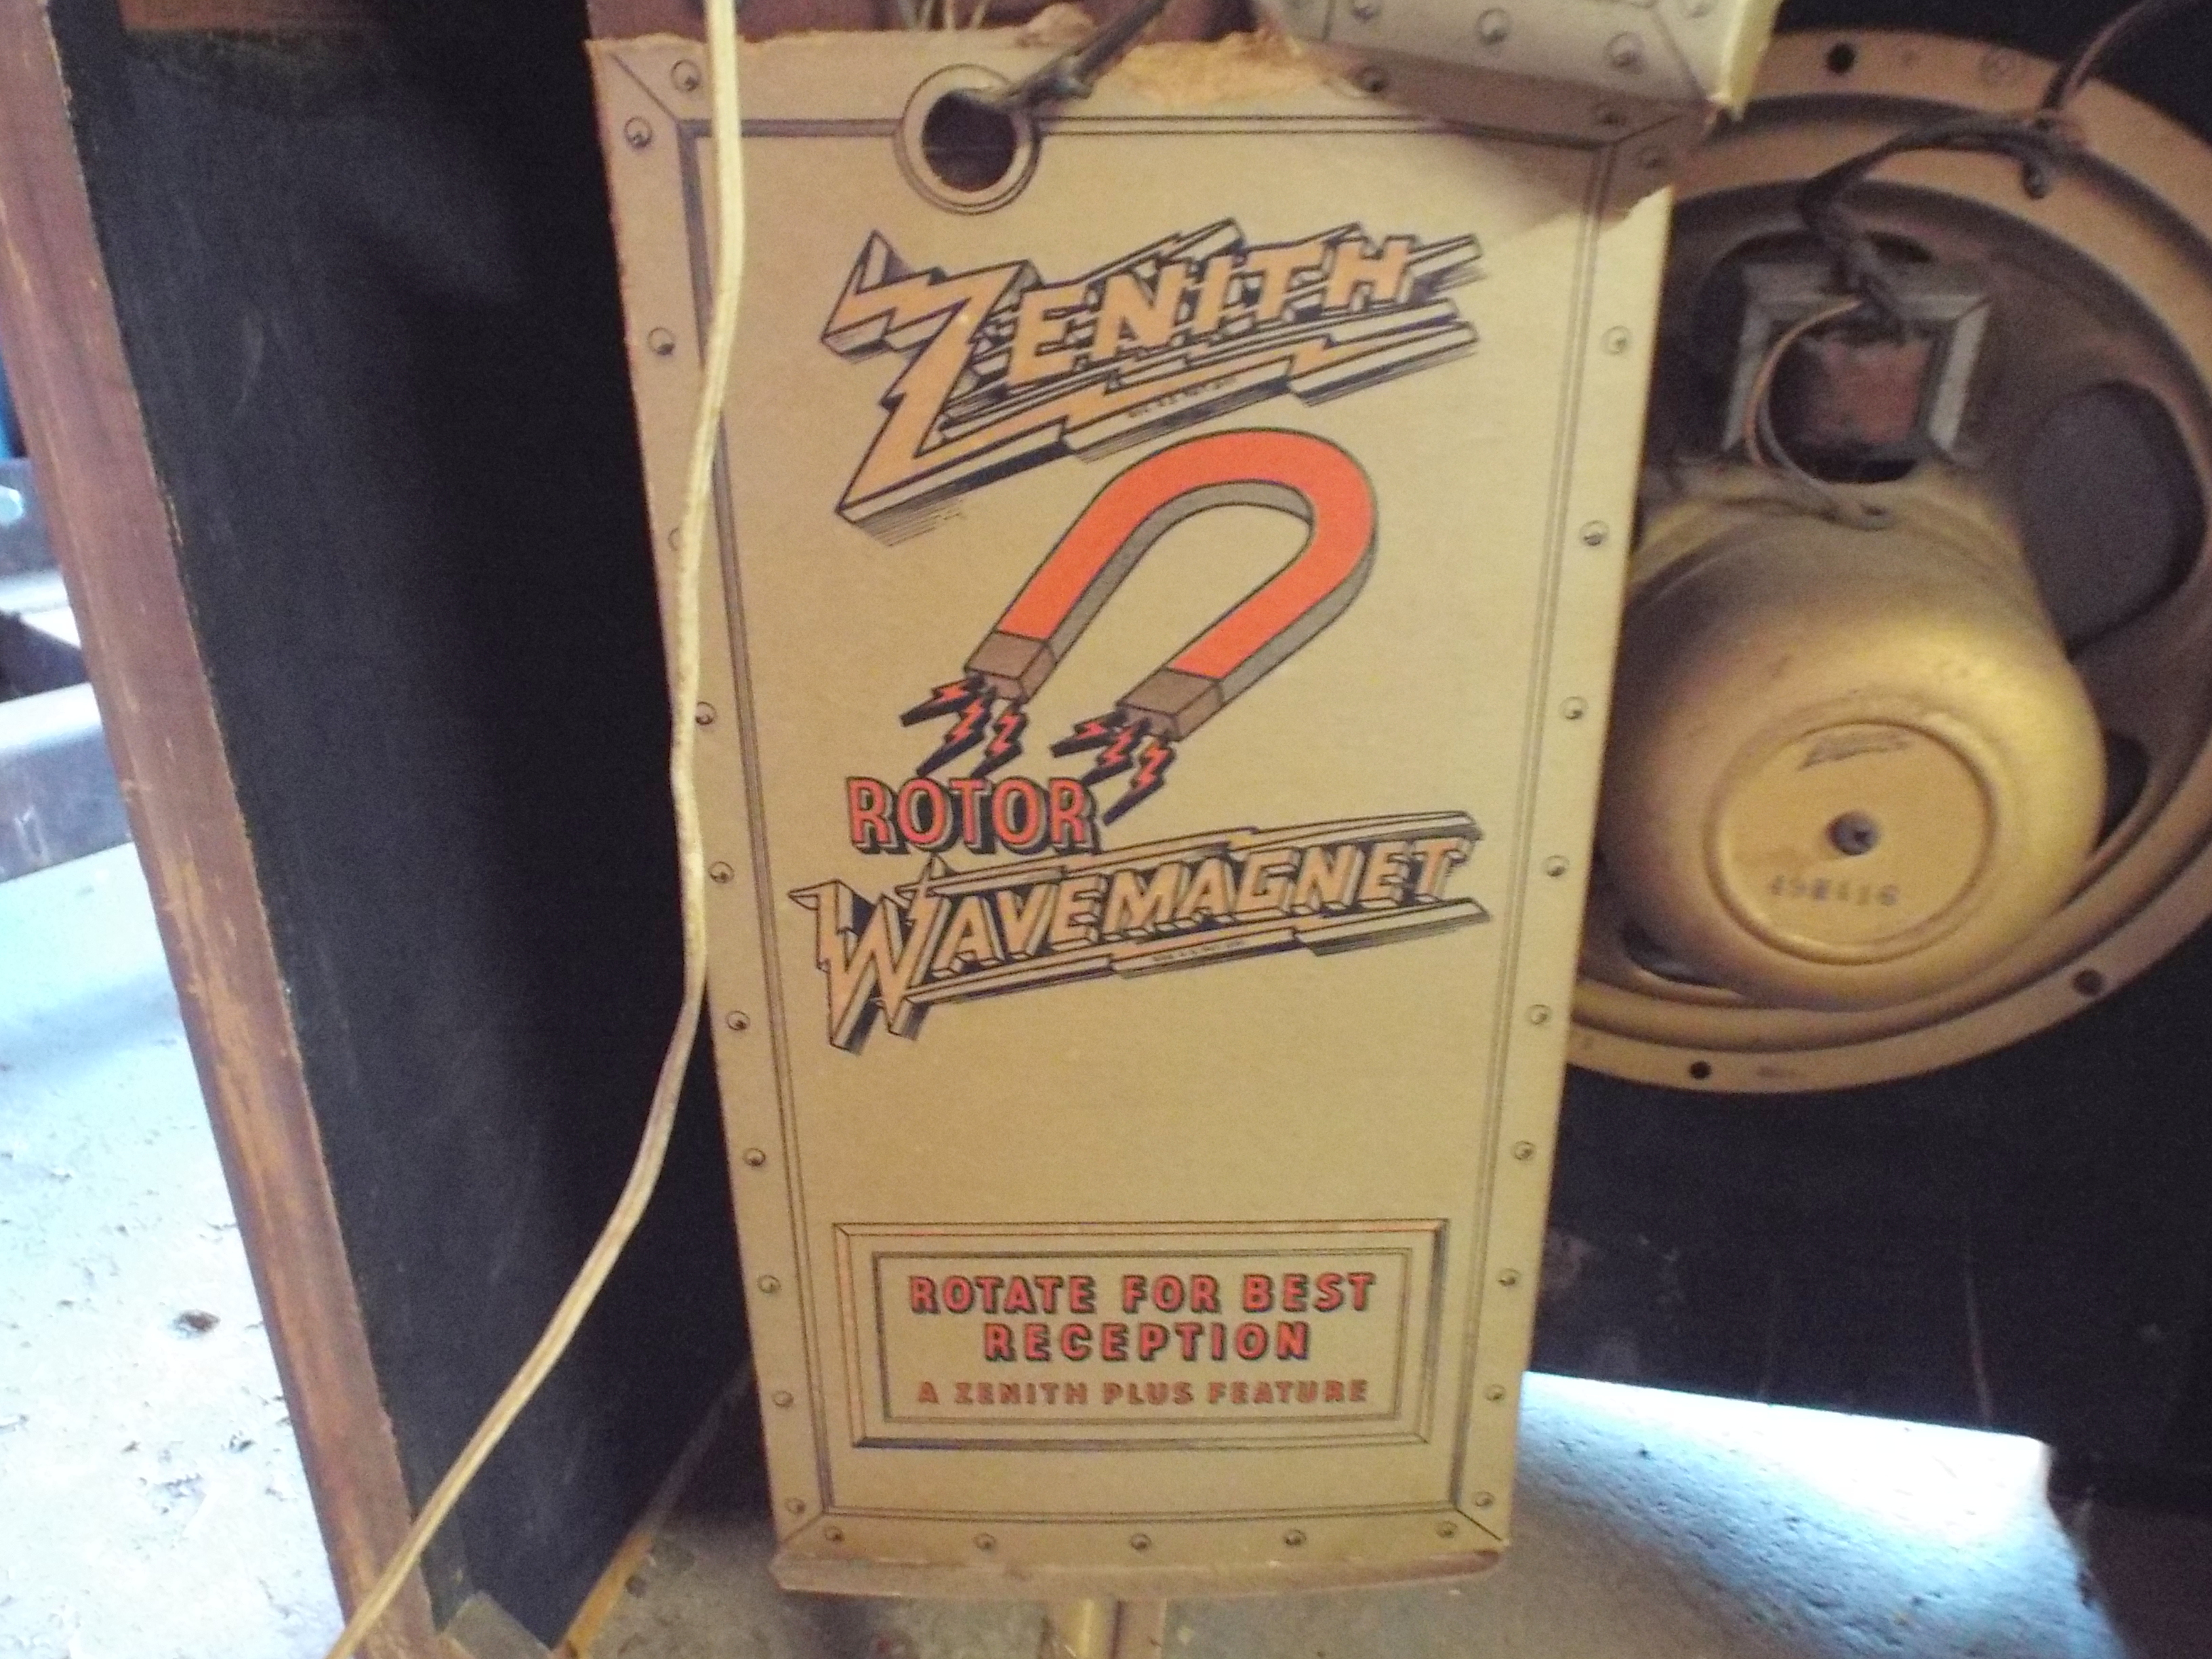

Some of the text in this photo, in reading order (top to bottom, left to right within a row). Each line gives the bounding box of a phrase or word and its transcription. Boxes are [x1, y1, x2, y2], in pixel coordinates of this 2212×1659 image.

[821, 220, 1484, 532] ZENITH
[846, 777, 1098, 853] ROTOR
[789, 821, 1490, 1054] WAVEMAGNET
[909, 1271, 1375, 1314] ROTATE FOR BEST
[984, 1321, 1311, 1361] RECEPTION
[918, 1378, 1370, 1406] A ZENITH PLUS FEATURE
